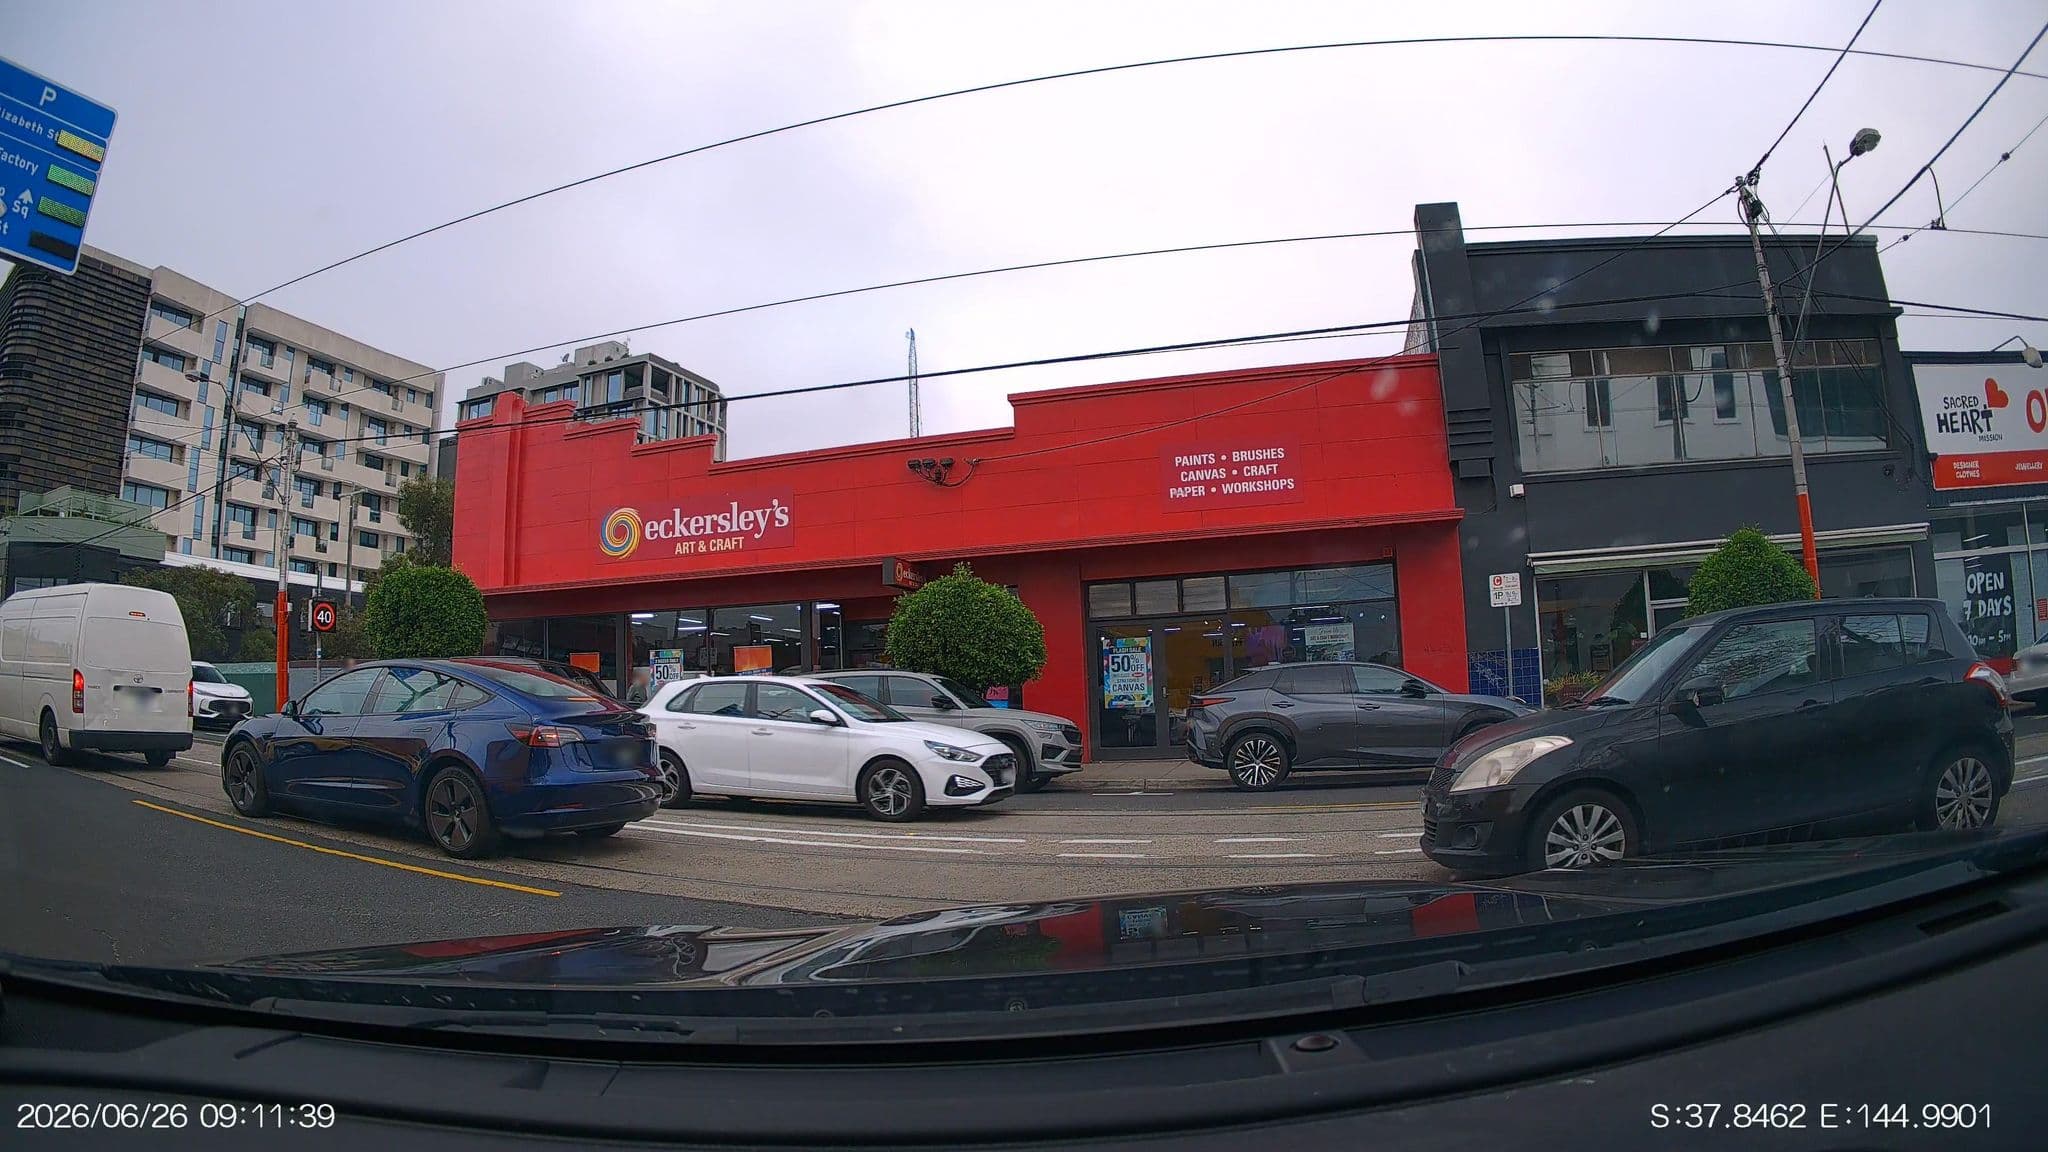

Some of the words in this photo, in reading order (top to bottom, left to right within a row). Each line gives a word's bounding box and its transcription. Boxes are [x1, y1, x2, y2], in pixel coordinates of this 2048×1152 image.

[39, 86, 57, 107] P
[0, 107, 43, 136] izabeth
[12, 200, 29, 219] Sq
[1943, 395, 1979, 409] SACRED
[2026, 388, 2048, 433] O
[1936, 405, 1993, 434] HEART
[1175, 454, 1215, 467] PAINTS
[1232, 448, 1285, 462] BRUSHES
[1181, 468, 1226, 482] CANVAS
[1243, 464, 1278, 477] CRAFT
[1956, 469, 1980, 478] CLOTHES
[1170, 485, 1205, 498] PAPER
[1222, 478, 1294, 494] WORKSHOPS
[645, 499, 789, 540] eckersley's
[675, 542, 696, 555] ART
[698, 540, 707, 552] &
[710, 537, 744, 551] CRAFT
[1966, 572, 2004, 594] OPEN
[1494, 592, 1503, 600] 1P
[317, 610, 331, 623] 40
[1963, 600, 1971, 620] 7
[1978, 595, 2012, 618] DAYS
[1131, 664, 1144, 672] OFF
[1112, 683, 1145, 692] CANVAS
